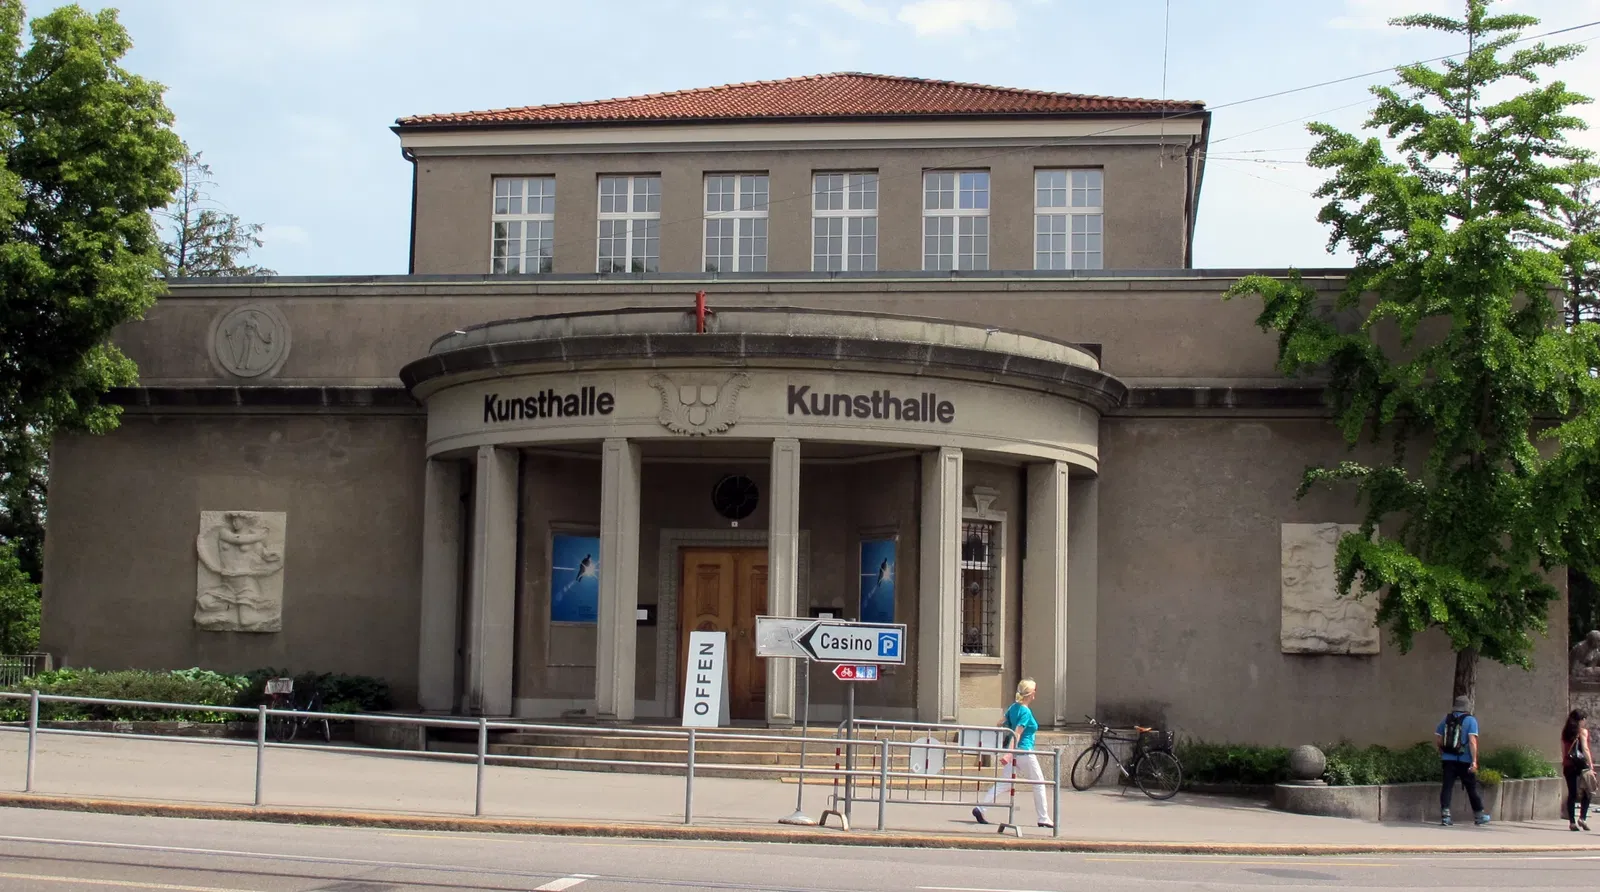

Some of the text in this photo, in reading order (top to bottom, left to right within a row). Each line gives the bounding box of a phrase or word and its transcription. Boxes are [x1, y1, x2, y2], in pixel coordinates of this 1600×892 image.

[484, 386, 615, 422] Kunsthalle
[787, 385, 955, 424] Kunsthalle
[820, 632, 894, 654] Casino P
[694, 643, 714, 715] OFFEN
